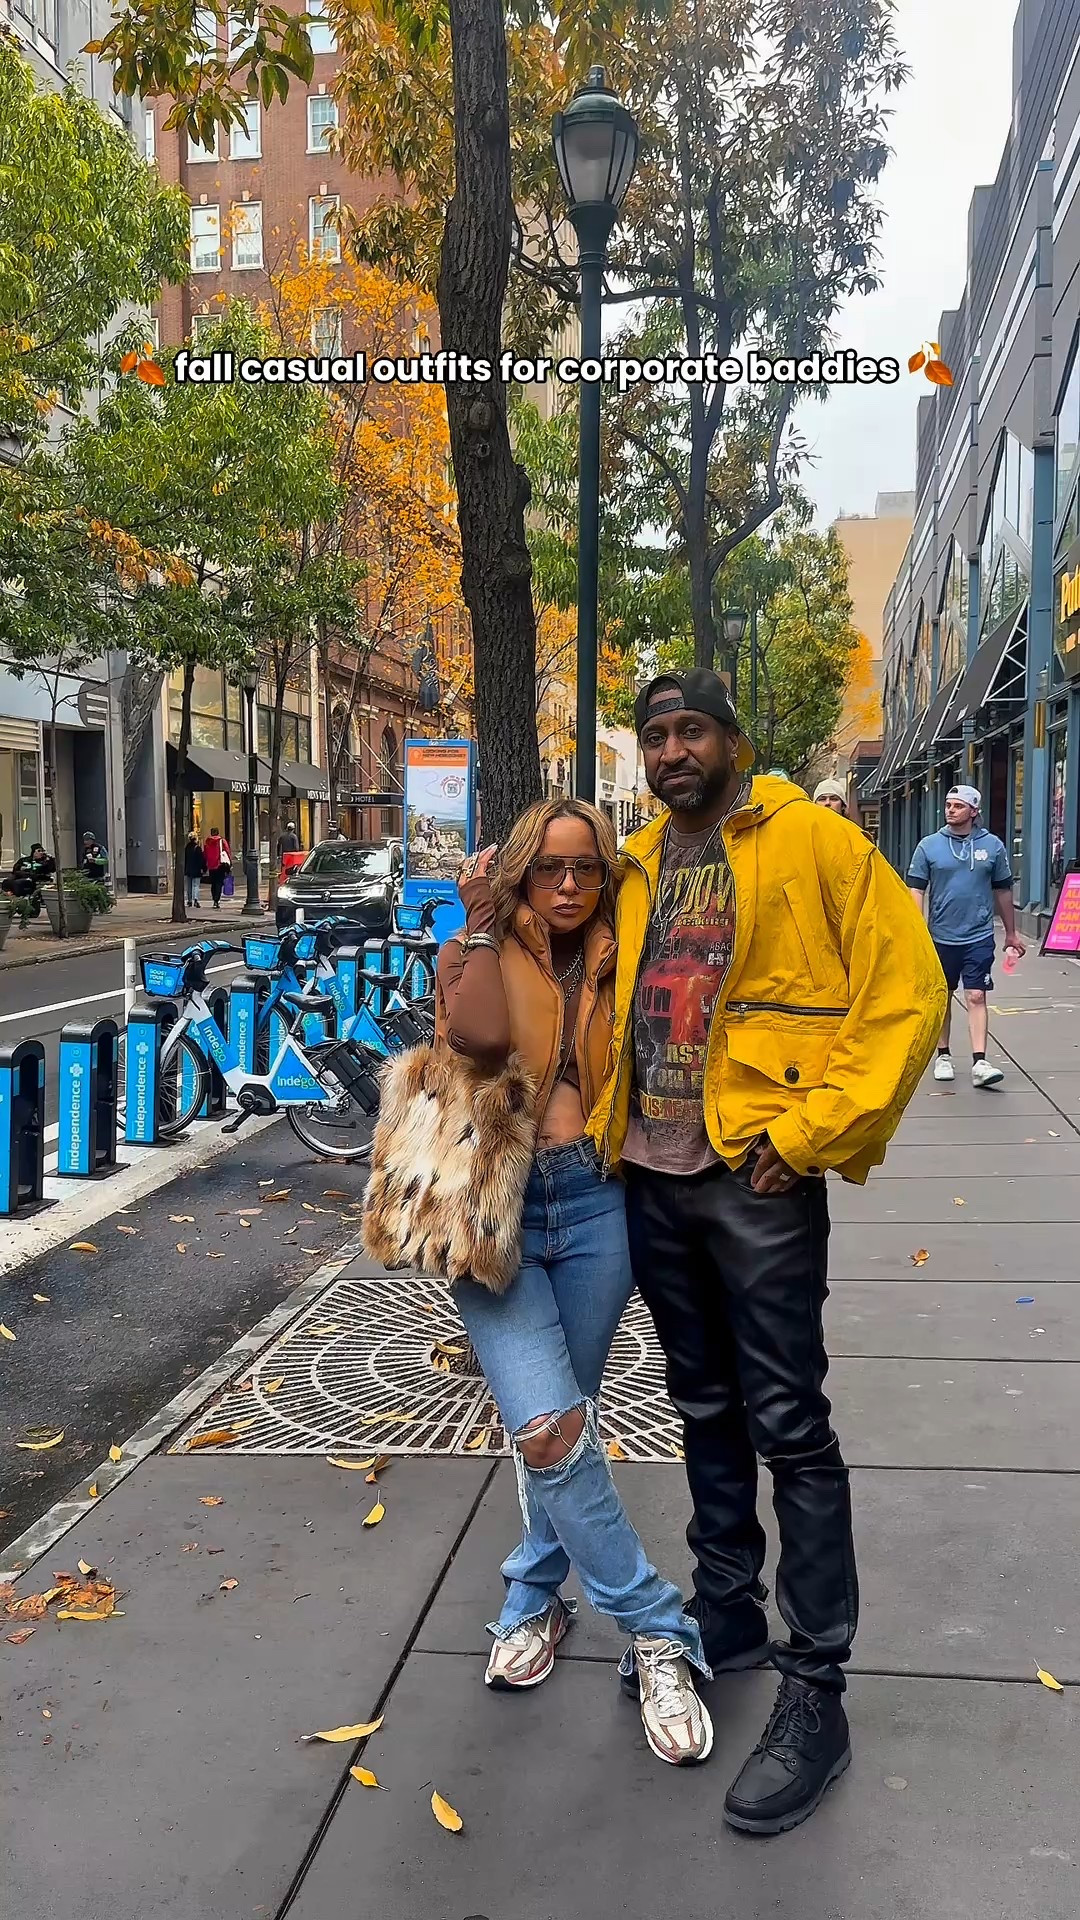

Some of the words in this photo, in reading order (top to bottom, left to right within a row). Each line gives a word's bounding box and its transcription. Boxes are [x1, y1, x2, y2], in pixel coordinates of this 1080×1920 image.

[203, 1025, 226, 1061] Indego
[237, 1021, 248, 1073] pendence
[134, 1056, 148, 1139] Independence
[277, 1073, 316, 1089] Indego
[68, 1079, 82, 1170] Independence
